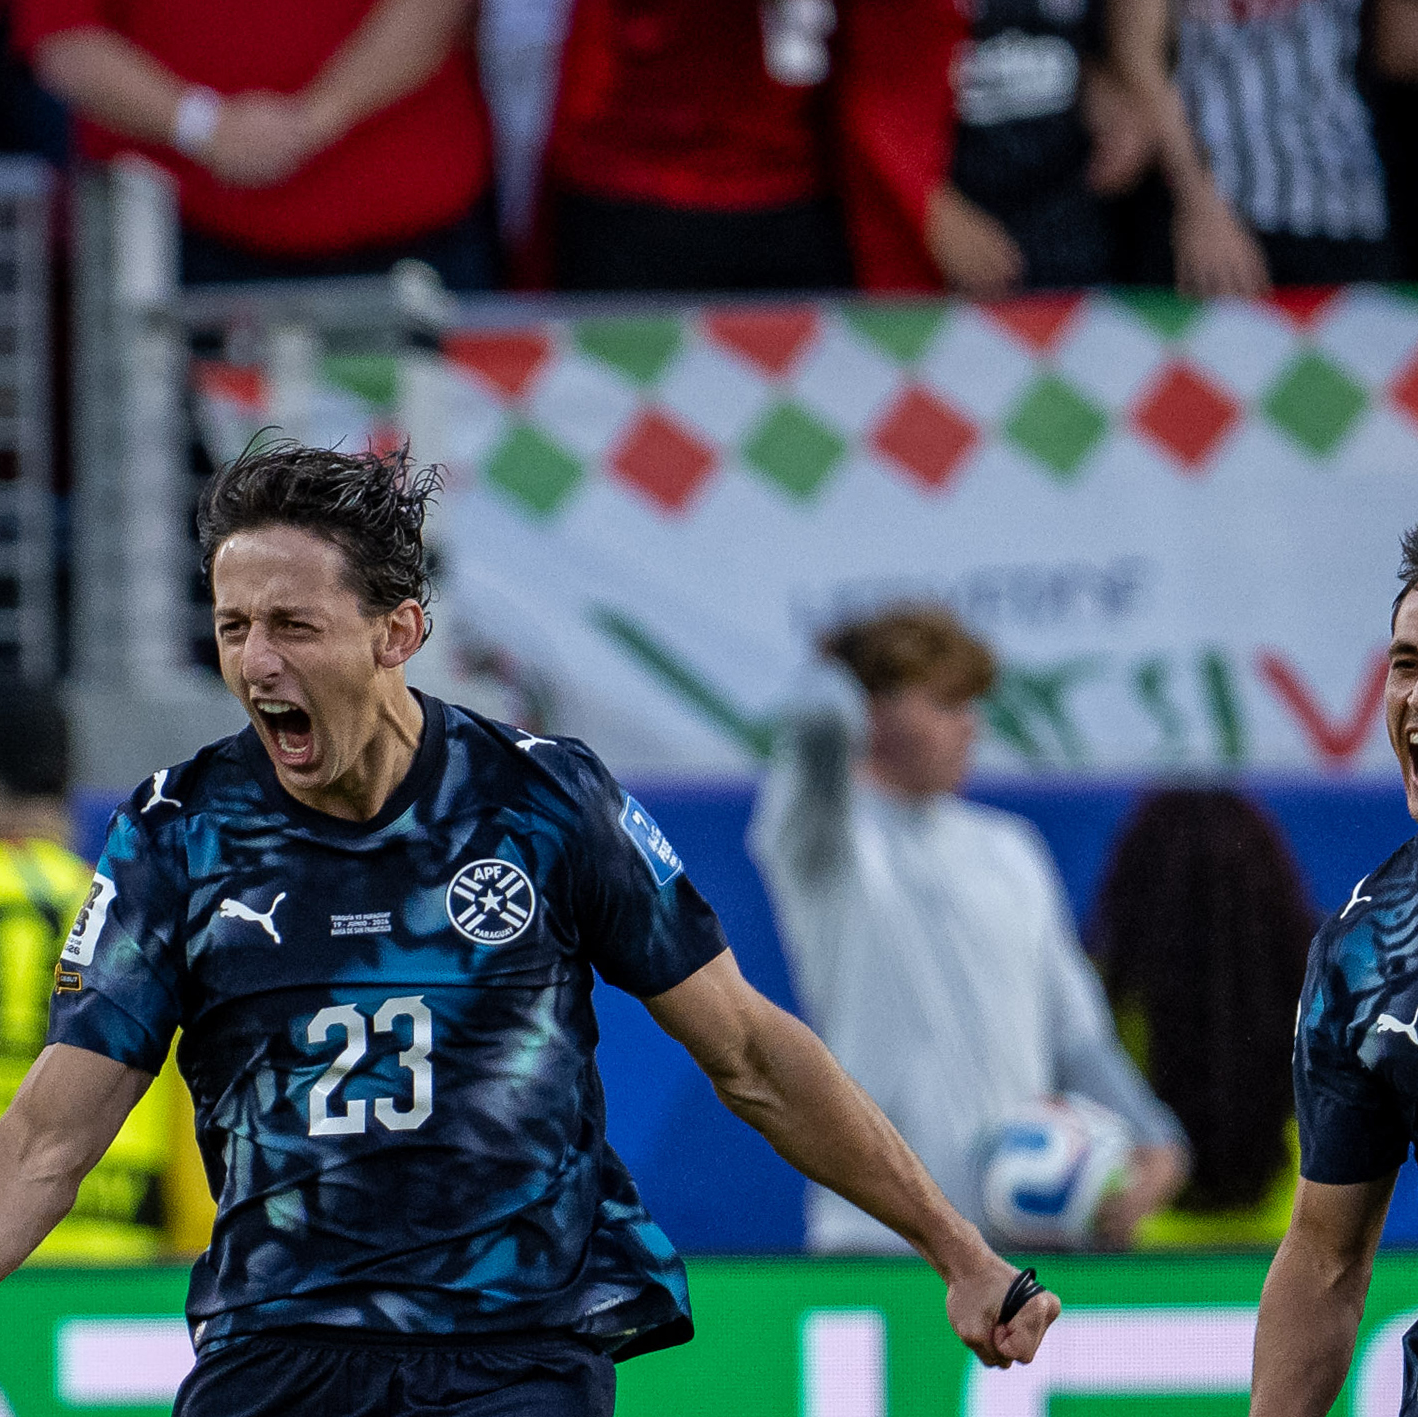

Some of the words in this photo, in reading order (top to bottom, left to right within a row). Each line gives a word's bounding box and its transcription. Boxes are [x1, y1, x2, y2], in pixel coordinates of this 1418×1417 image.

[473, 865, 503, 881] APF
[473, 926, 514, 939] PARAGUAY
[306, 995, 434, 1137] 23
